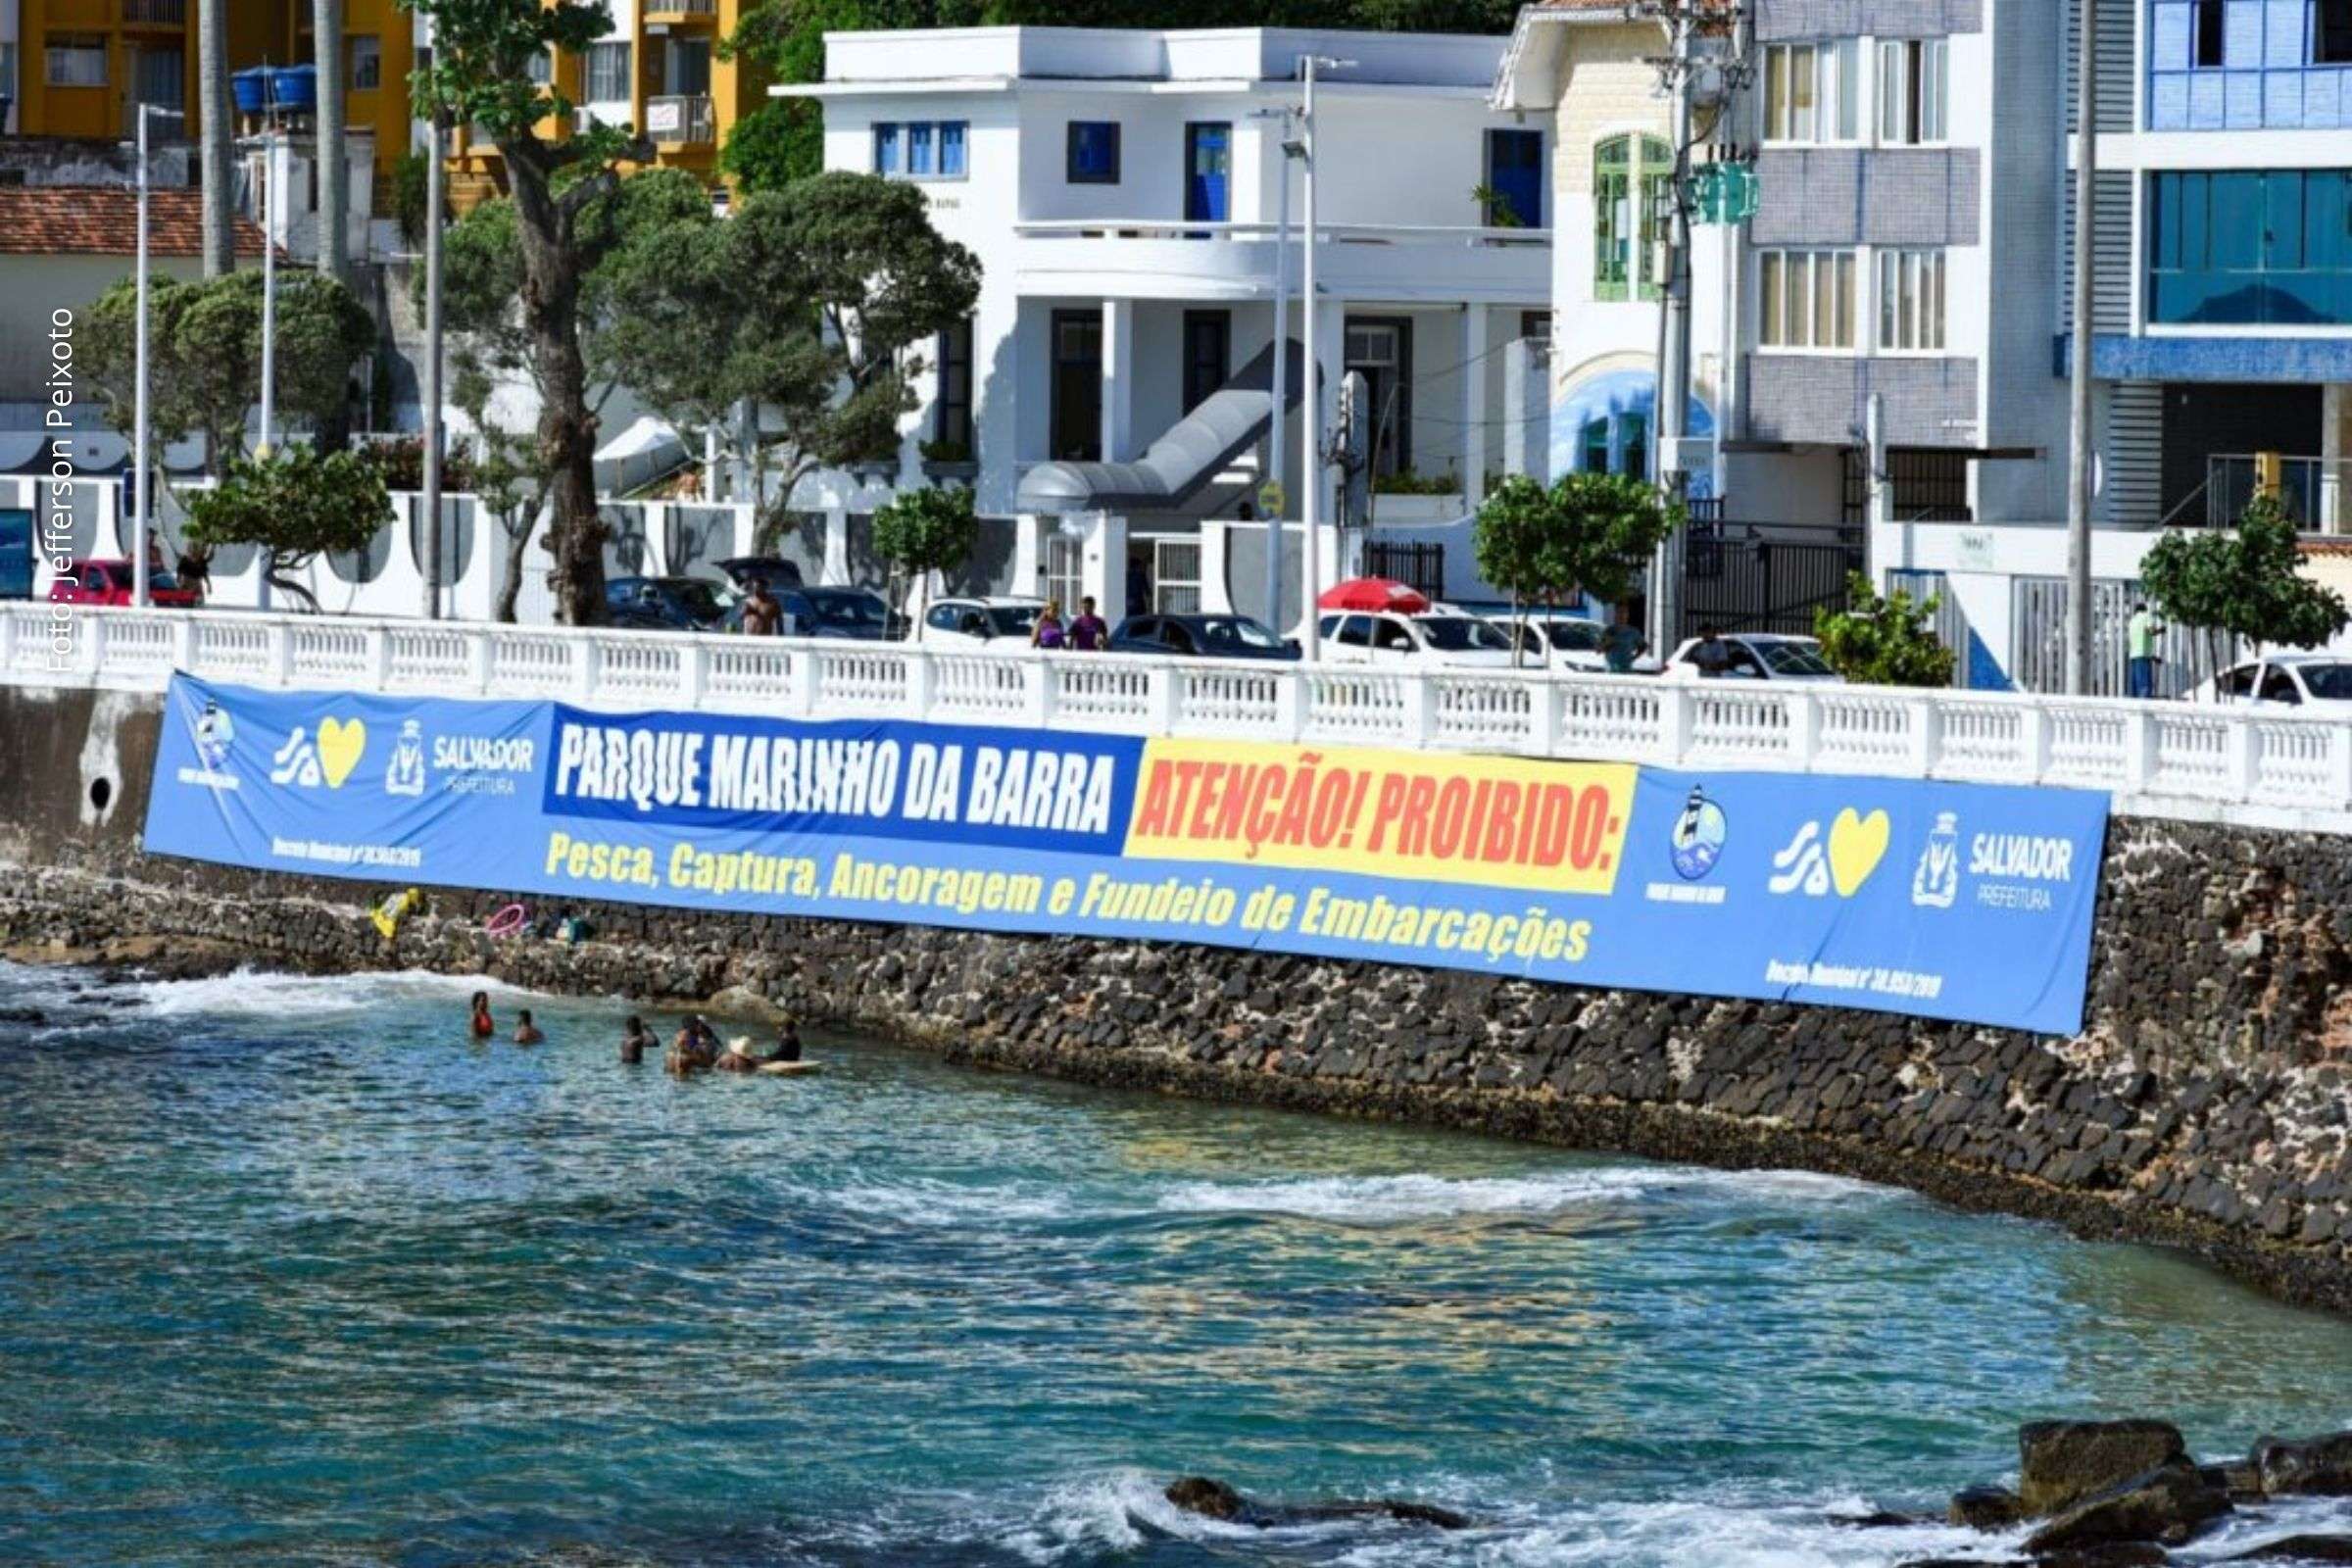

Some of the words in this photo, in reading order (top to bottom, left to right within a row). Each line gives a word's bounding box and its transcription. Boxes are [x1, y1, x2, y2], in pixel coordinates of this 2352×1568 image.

[432, 736, 534, 772] SALVADOR
[555, 724, 703, 811] PARQUE
[708, 734, 900, 817] MARINHO
[902, 743, 963, 822] DA
[965, 747, 1114, 833] BARRA
[1135, 752, 1371, 859] ATENÇÃO!
[1366, 772, 1620, 871] PROIBIDO:
[1968, 832, 2073, 883] SALVADOR
[545, 832, 660, 889] Pesca,
[668, 844, 820, 902] Captura,
[827, 854, 1041, 916] Ancoragem
[1048, 877, 1074, 915] e
[1080, 872, 1235, 928] Fundeio
[1241, 885, 1294, 932] de
[1298, 893, 1592, 963] Embarcações
